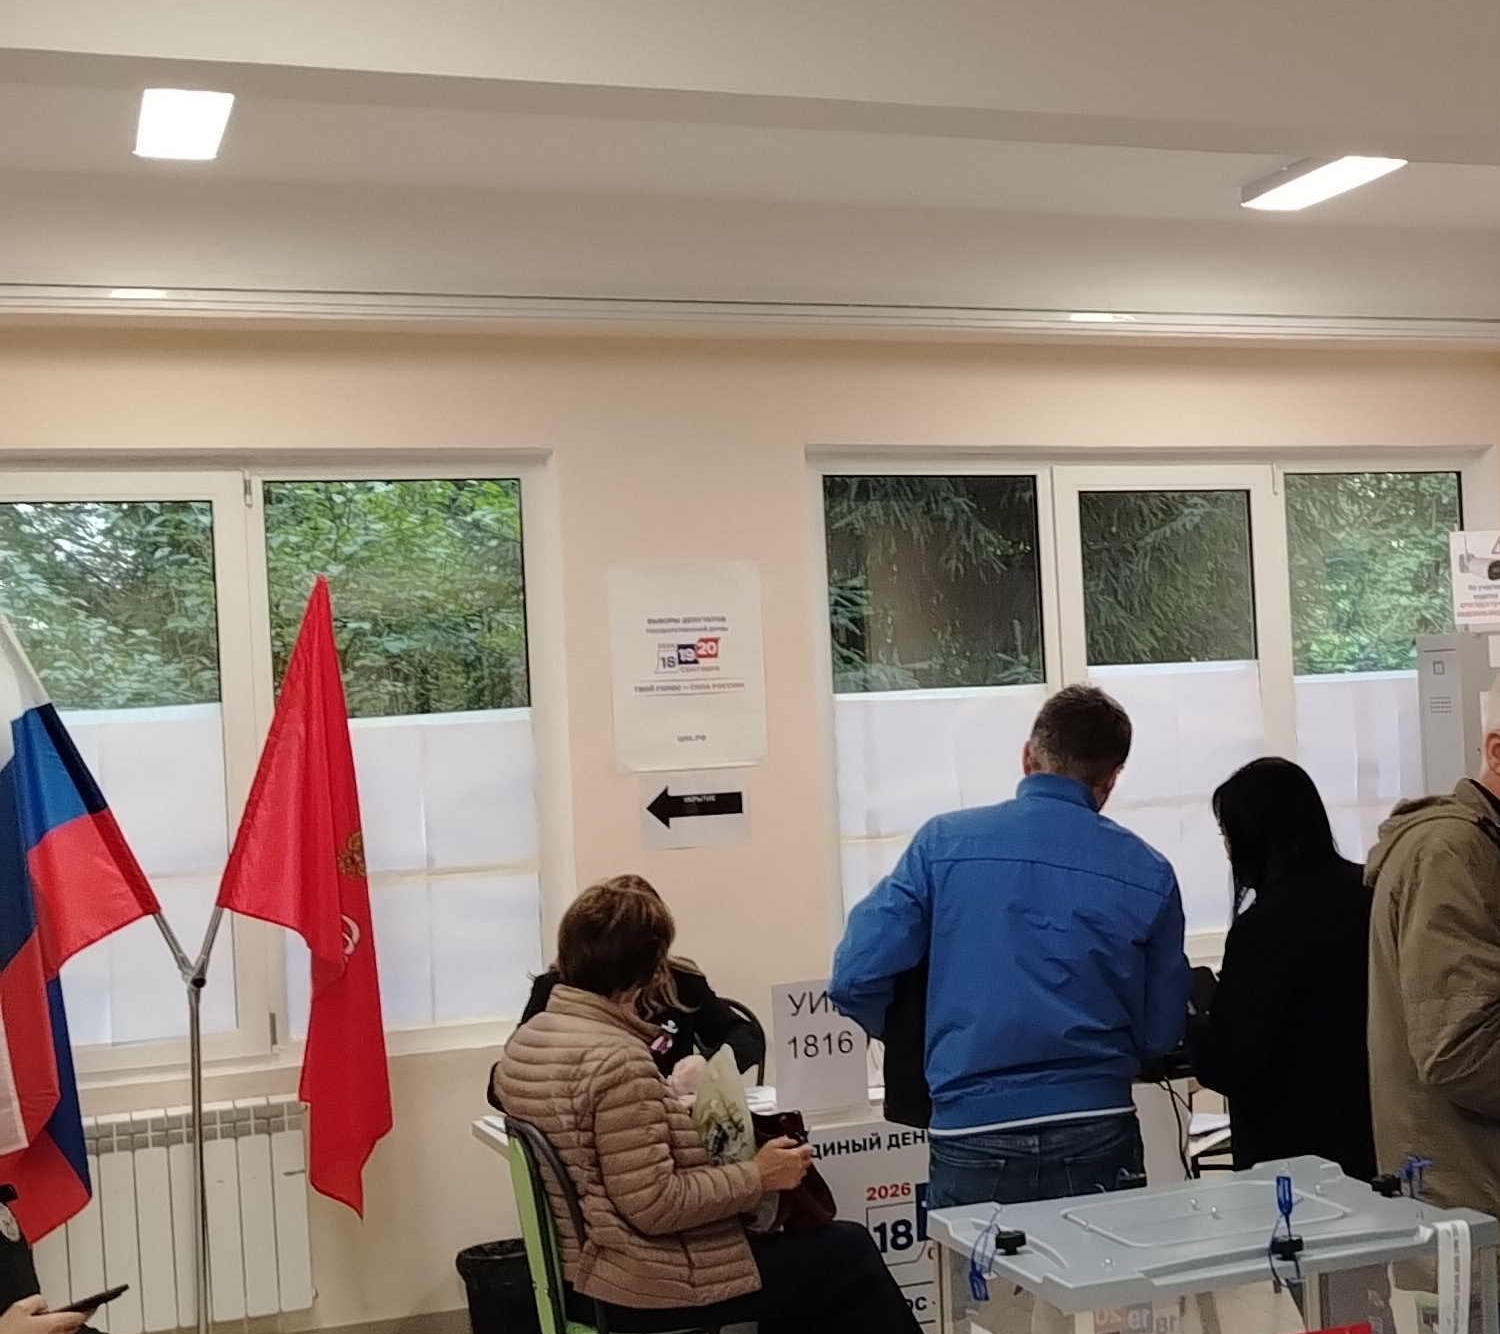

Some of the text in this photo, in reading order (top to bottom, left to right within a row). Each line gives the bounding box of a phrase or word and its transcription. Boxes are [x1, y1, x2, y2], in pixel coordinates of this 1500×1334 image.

[661, 642, 717, 668] 18 19 20
[787, 990, 837, 1017] УИ
[788, 1030, 854, 1059] 1816
[811, 1132, 882, 1160] ДИНЫЙ
[866, 1182, 912, 1202] 2026
[873, 1218, 914, 1254] 18
